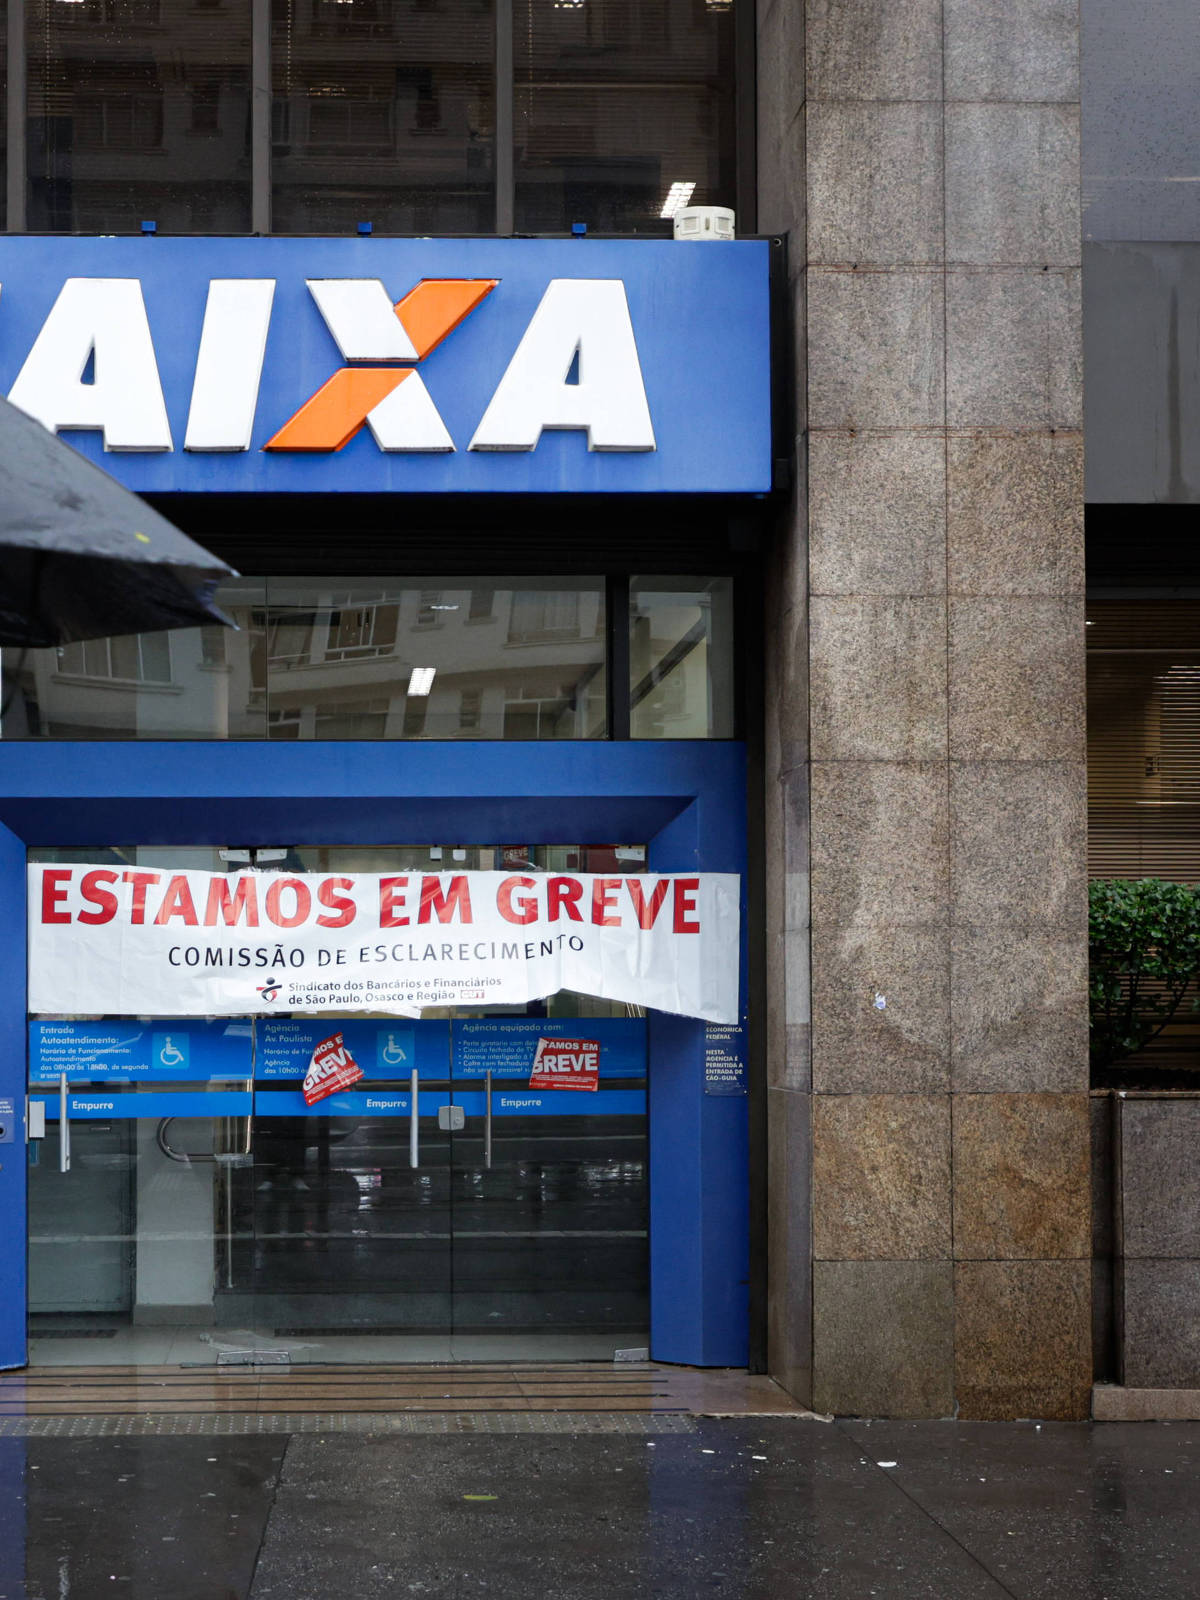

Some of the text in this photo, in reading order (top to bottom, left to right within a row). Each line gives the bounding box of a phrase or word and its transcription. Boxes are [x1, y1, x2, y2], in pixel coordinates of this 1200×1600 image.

[41, 869, 700, 934] ESTAMOS EM GREVE
[168, 934, 584, 968] COMISSÃO DE ESCLARECIMENTO
[288, 981, 341, 992] Sindicato
[344, 980, 364, 991] dos
[367, 978, 422, 990] Bancários
[433, 976, 502, 988] Financiários
[288, 990, 455, 1005] de São Paulo, Osasco e Região
[40, 1025, 75, 1034] Entrada
[264, 1023, 300, 1033] Agência
[462, 1023, 498, 1033] Agência
[500, 1024, 541, 1033] equipada
[40, 1036, 120, 1045] Autoatendimento:
[279, 1034, 313, 1042] Paulista
[542, 1041, 580, 1051] TAMOS
[582, 1043, 599, 1051] EM
[40, 1063, 52, 1071] das
[122, 1063, 149, 1071] segunda
[264, 1059, 290, 1067] Agência
[534, 1053, 599, 1074] GREVE
[72, 1101, 114, 1111] Empurre
[366, 1098, 408, 1109] Empurre
[500, 1098, 542, 1108] Empurre
